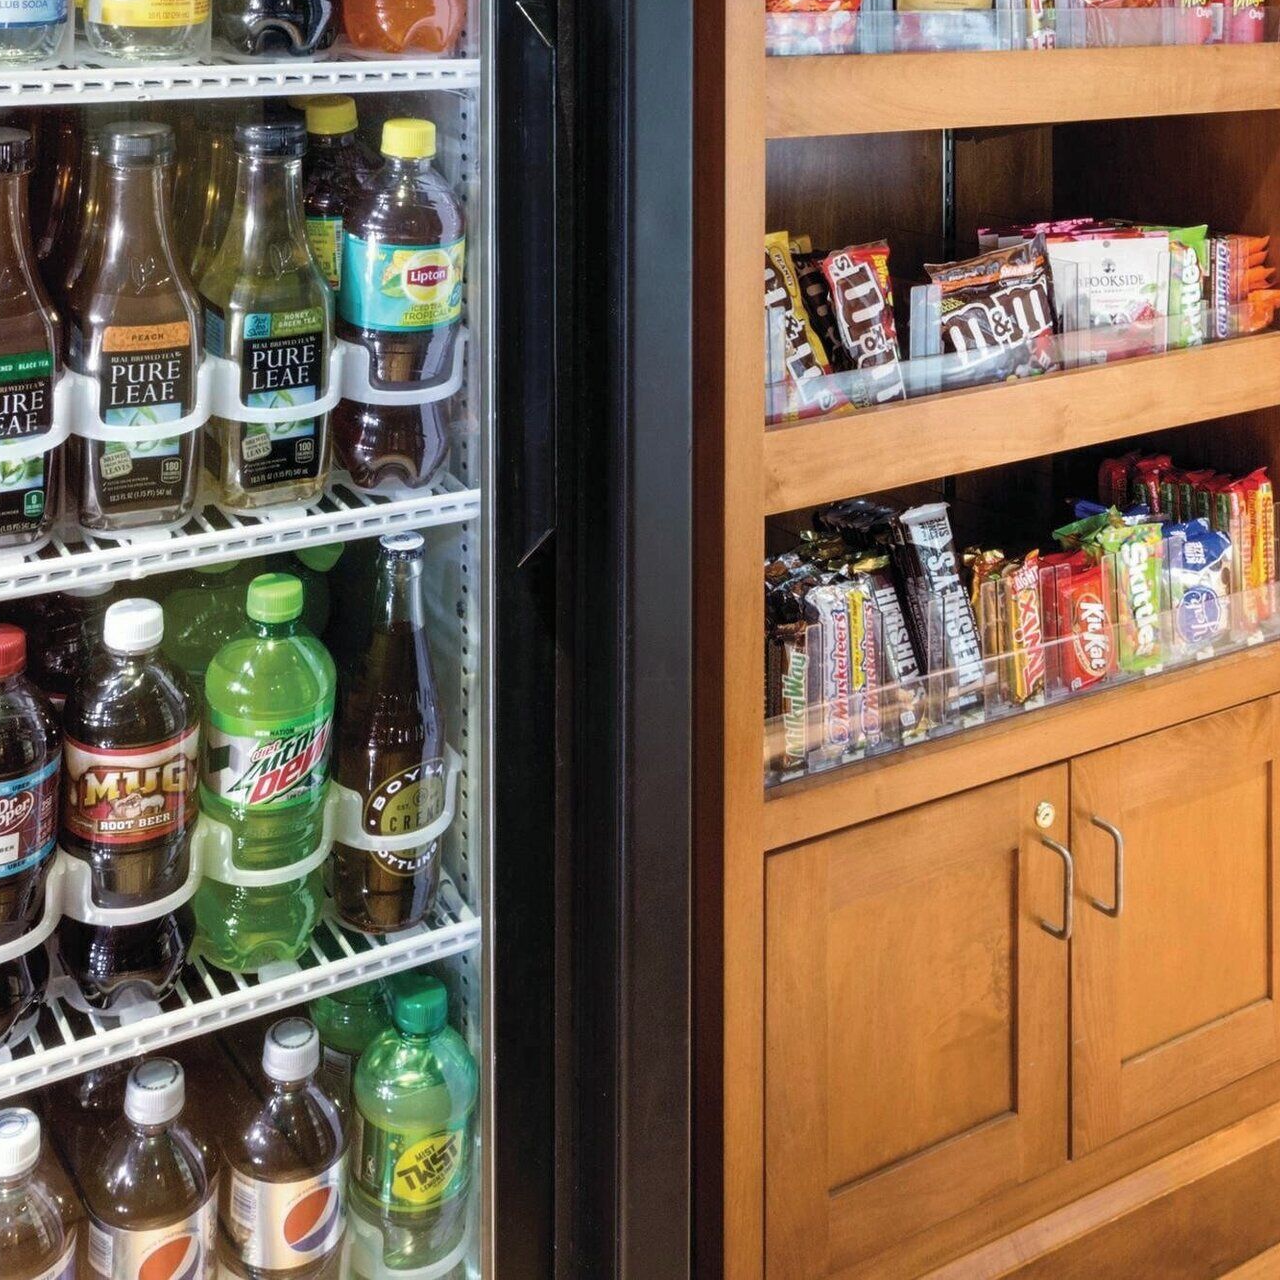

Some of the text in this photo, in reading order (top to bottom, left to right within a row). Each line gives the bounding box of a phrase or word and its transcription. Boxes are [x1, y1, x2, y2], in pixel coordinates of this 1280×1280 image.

[21, 0, 48, 10] SODA
[410, 269, 447, 285] Lipton
[131, 332, 165, 342] PEACH
[252, 344, 316, 372] PURE
[110, 359, 181, 387] PURE
[252, 366, 310, 392] LEAF
[110, 382, 175, 406] LEAF
[297, 441, 312, 452] 100
[164, 461, 180, 472] 180
[84, 761, 190, 807] MUG
[100, 812, 170, 831] ROOT BEER
[415, 1144, 436, 1162] MIST
